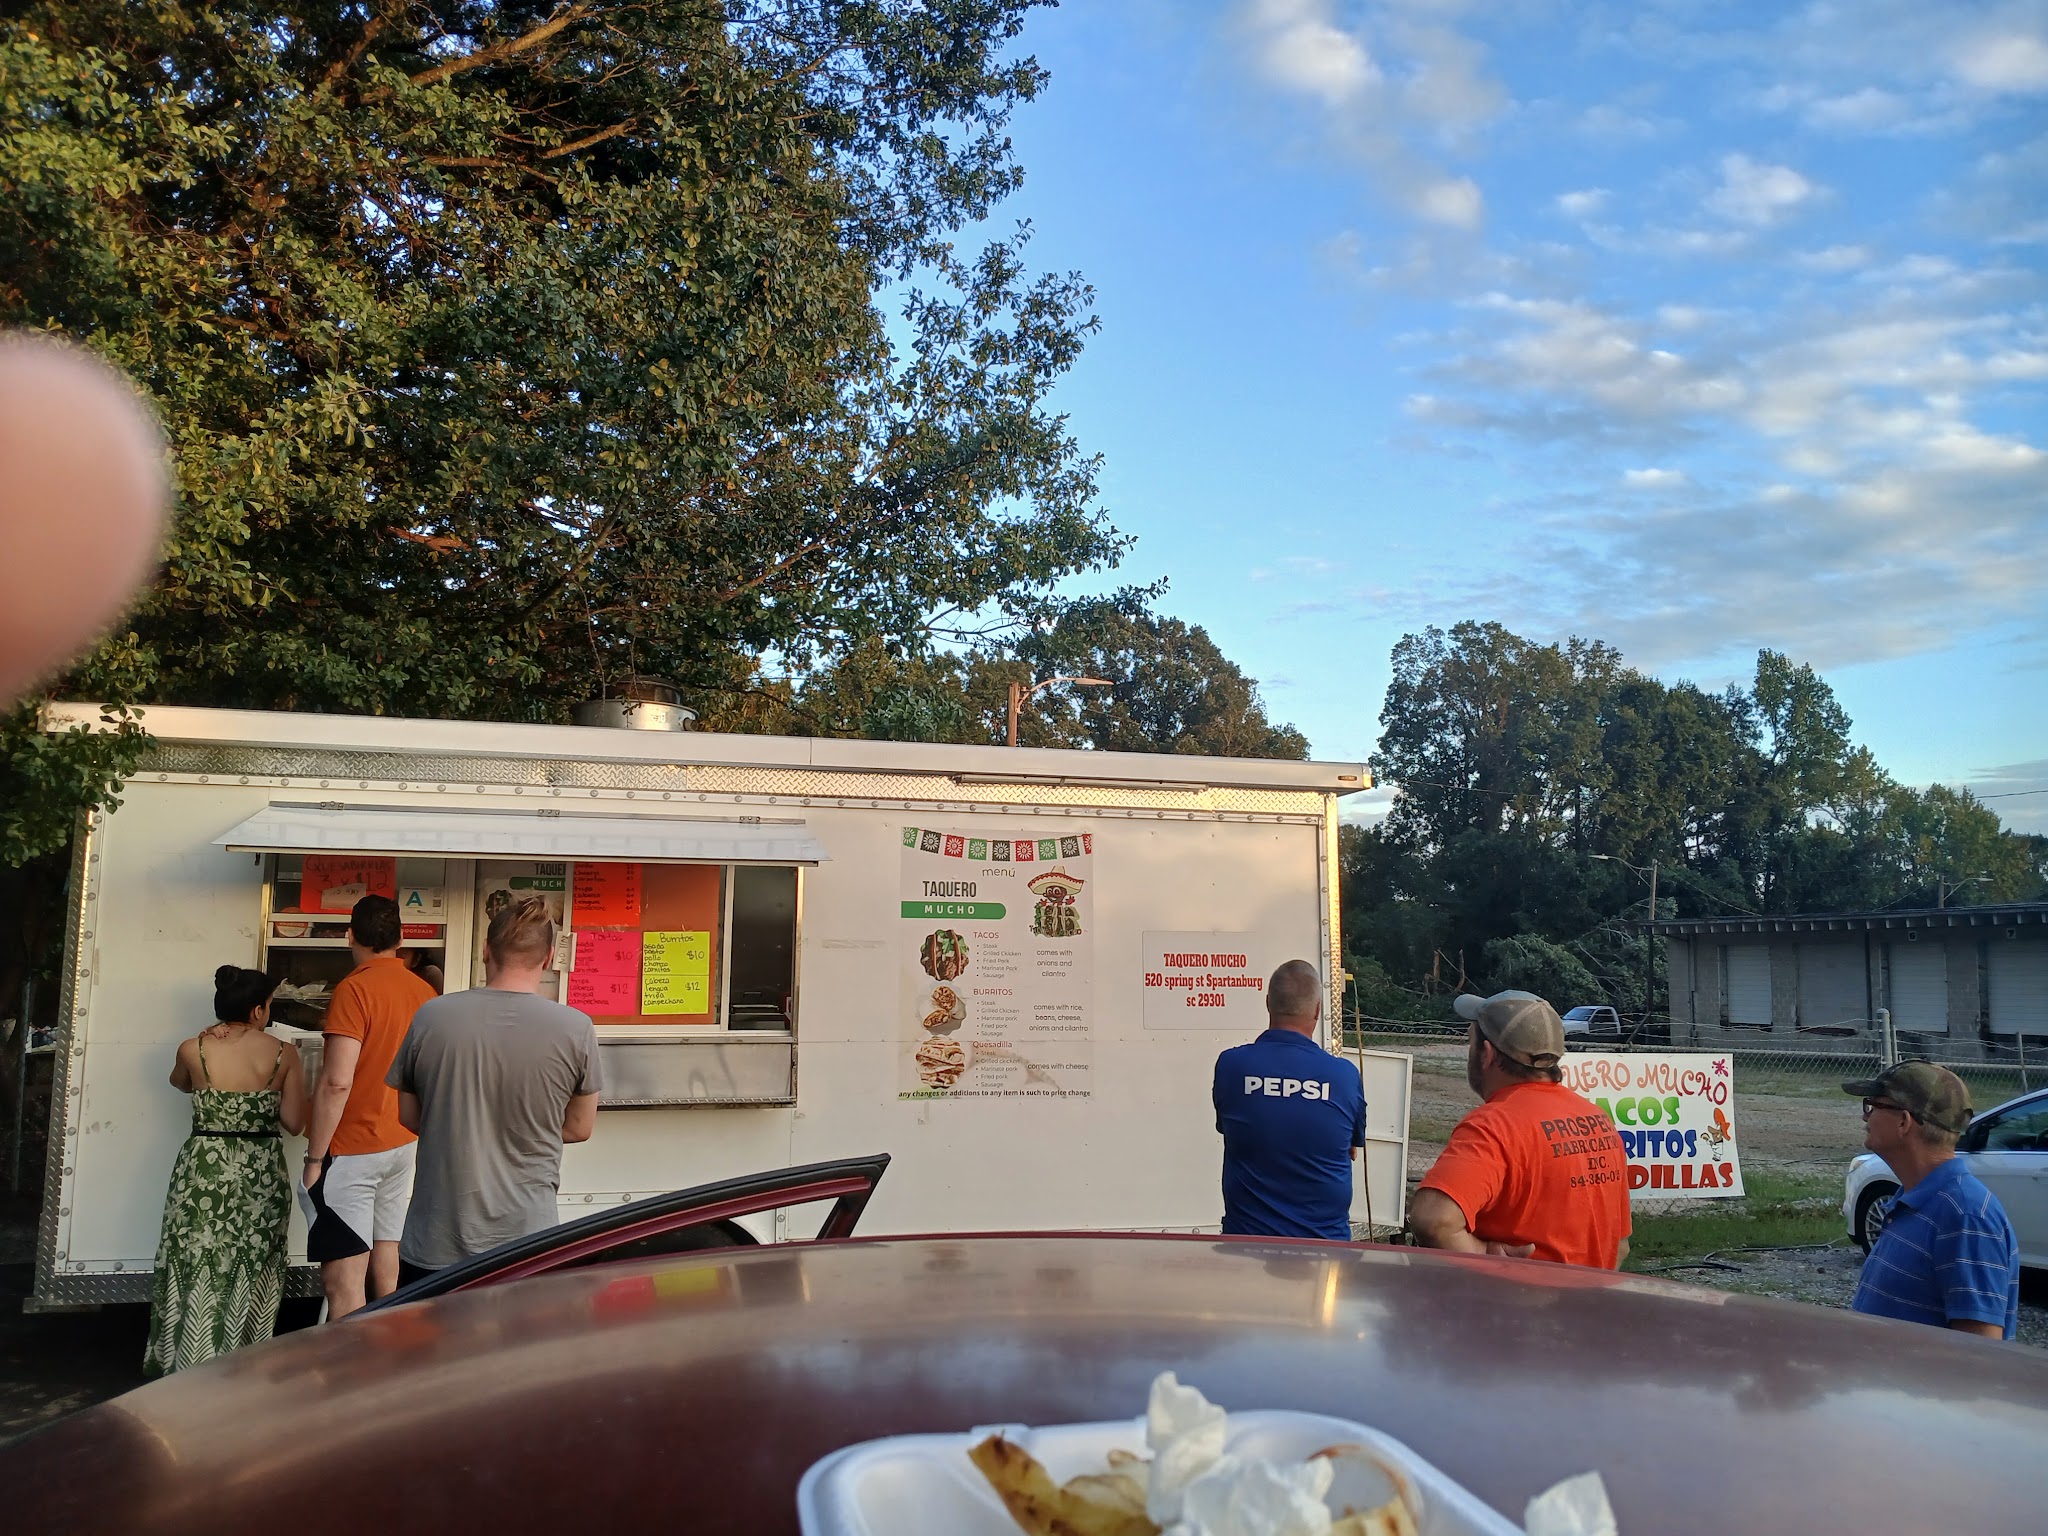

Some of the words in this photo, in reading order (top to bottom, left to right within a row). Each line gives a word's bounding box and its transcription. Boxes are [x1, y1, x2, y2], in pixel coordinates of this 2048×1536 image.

[982, 868, 1016, 878] menú
[923, 881, 977, 897] TAQUERO
[405, 891, 423, 906] A
[924, 905, 975, 914] MUCHO
[973, 931, 1000, 939] TACOS
[686, 950, 705, 960] $10
[1163, 953, 1208, 968] TAQUERO
[1211, 954, 1247, 967] MUCHO
[1041, 970, 1067, 978] cilantro
[685, 981, 700, 991] $12
[1145, 973, 1162, 987] 520
[1164, 974, 1194, 991] spring
[1195, 975, 1205, 987] st
[1206, 974, 1263, 991] Spartanburg
[610, 983, 628, 995] $12
[973, 988, 1013, 996] BURRITOS
[1186, 996, 1196, 1007] sc
[1198, 993, 1225, 1007] 29301
[1056, 1003, 1069, 1011] with
[1070, 1004, 1084, 1012] rice,
[1064, 1024, 1088, 1032] cilantro
[972, 1041, 1013, 1049] Quesadilla
[1065, 1062, 1089, 1070] cheese
[1562, 1059, 1631, 1093] UERO
[1637, 1063, 1727, 1105] MUCHO
[898, 1090, 911, 1098] any
[912, 1089, 940, 1097] changes
[950, 1088, 981, 1096] additions
[989, 1089, 1003, 1097] any
[1003, 1088, 1018, 1096] item
[1026, 1088, 1042, 1096] such
[1050, 1088, 1067, 1097] price
[1067, 1088, 1091, 1096] change
[1244, 1076, 1330, 1100] PEPSI
[1588, 1096, 1680, 1126] ACOS
[1618, 1129, 1697, 1160] RITOS
[1627, 1163, 1734, 1190] DILLAS
